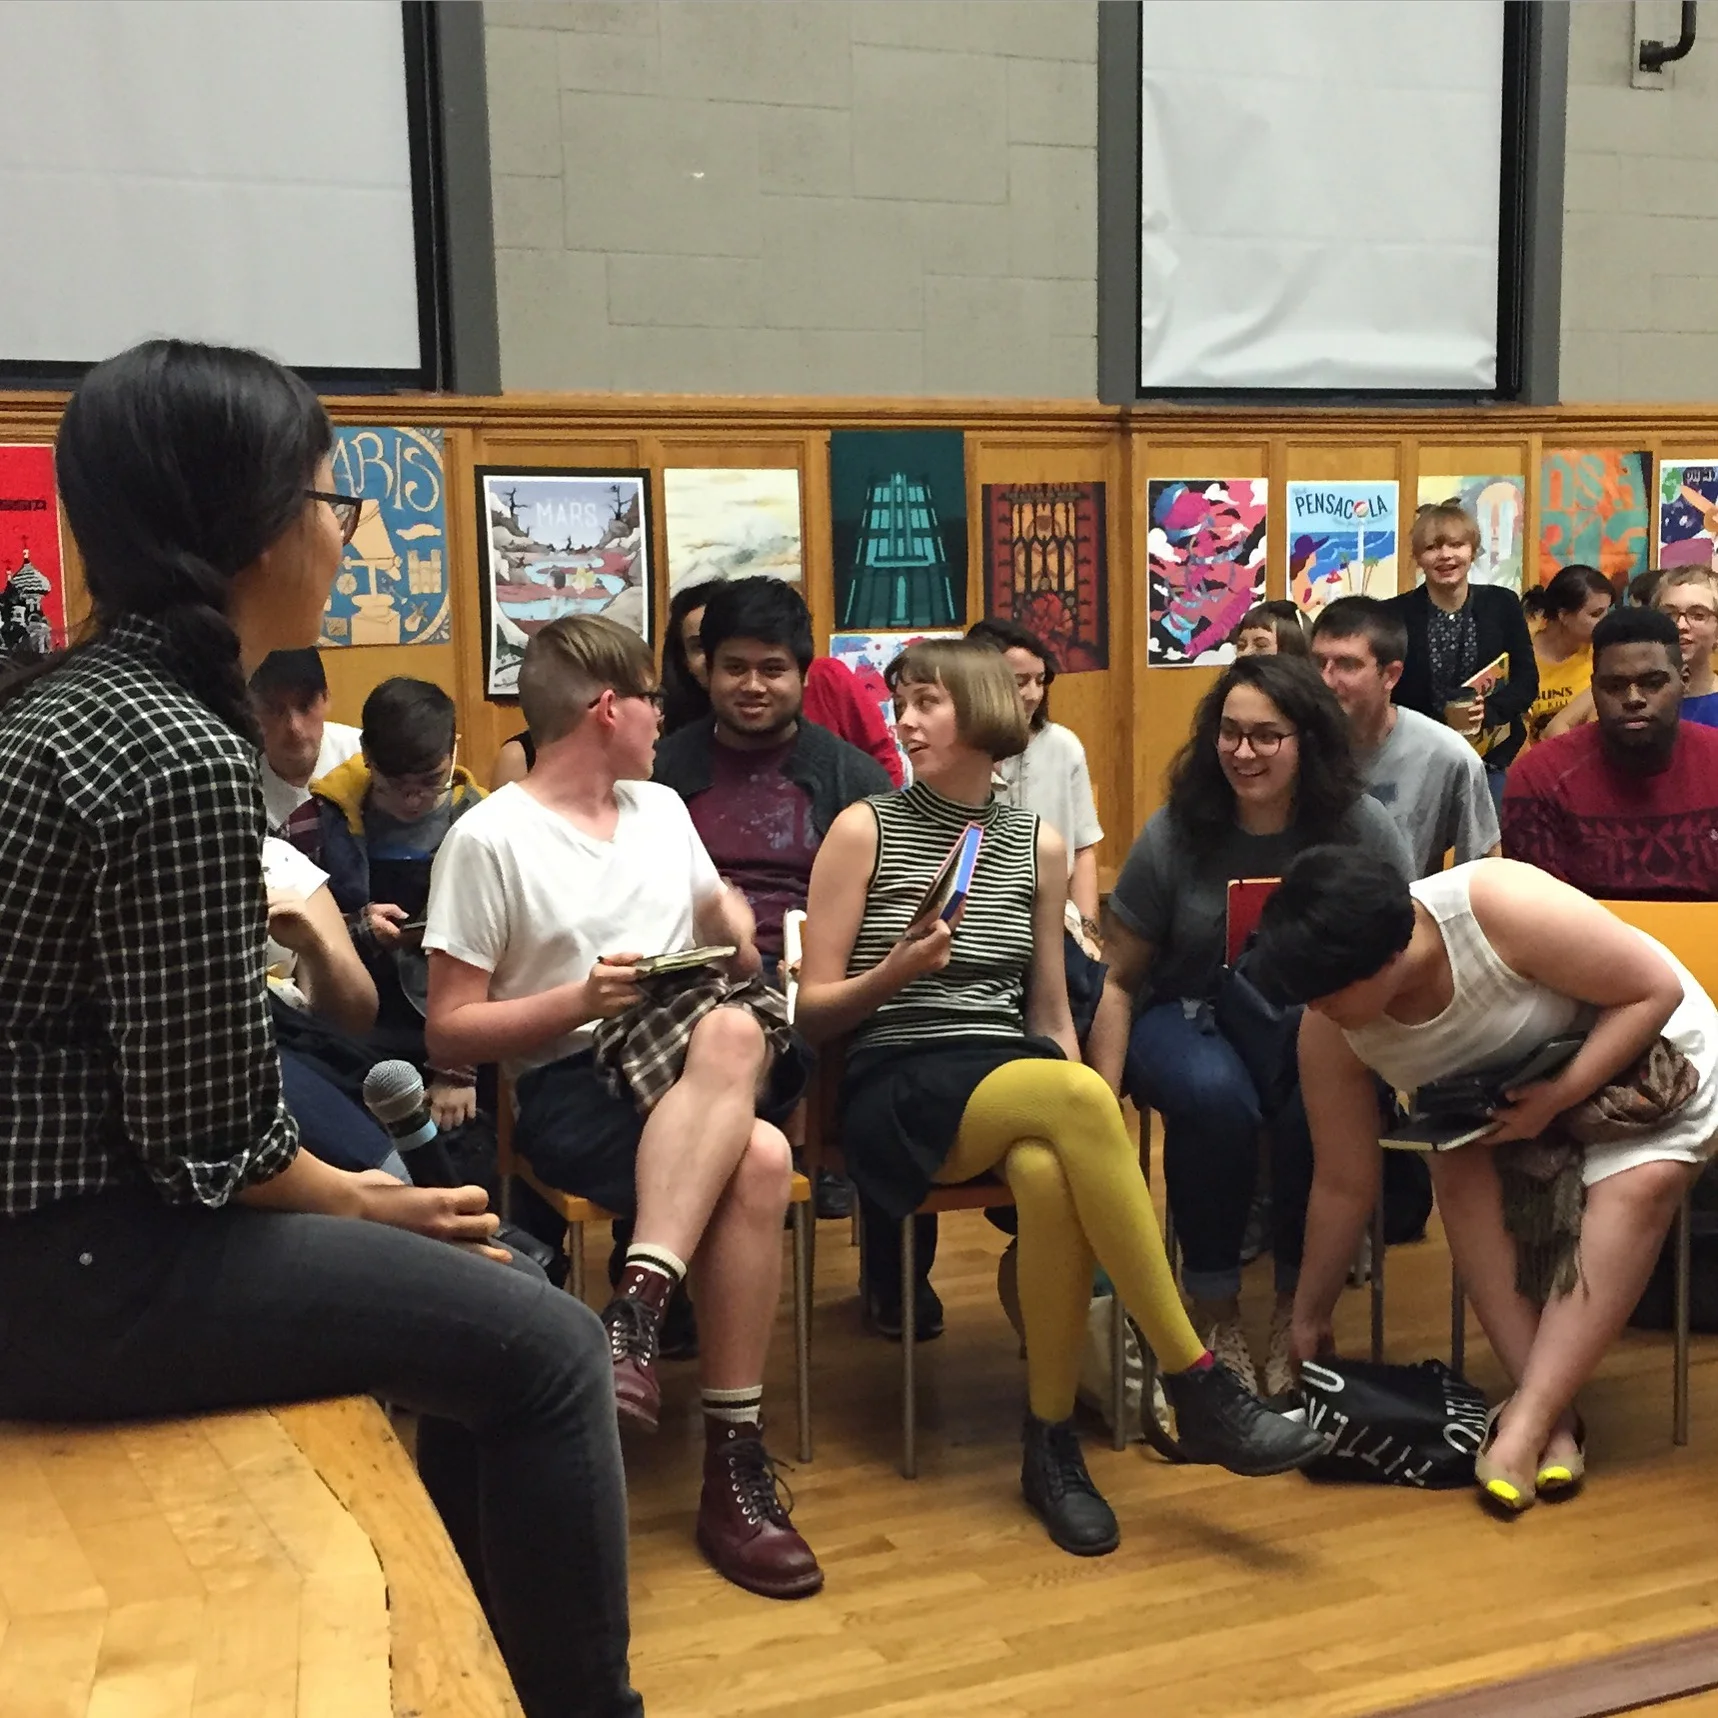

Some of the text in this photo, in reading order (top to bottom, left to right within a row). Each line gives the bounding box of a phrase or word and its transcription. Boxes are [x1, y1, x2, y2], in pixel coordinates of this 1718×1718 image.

[331, 431, 440, 513] ARIS
[536, 501, 599, 529] MARS
[1295, 493, 1388, 520] PENSACOLA
